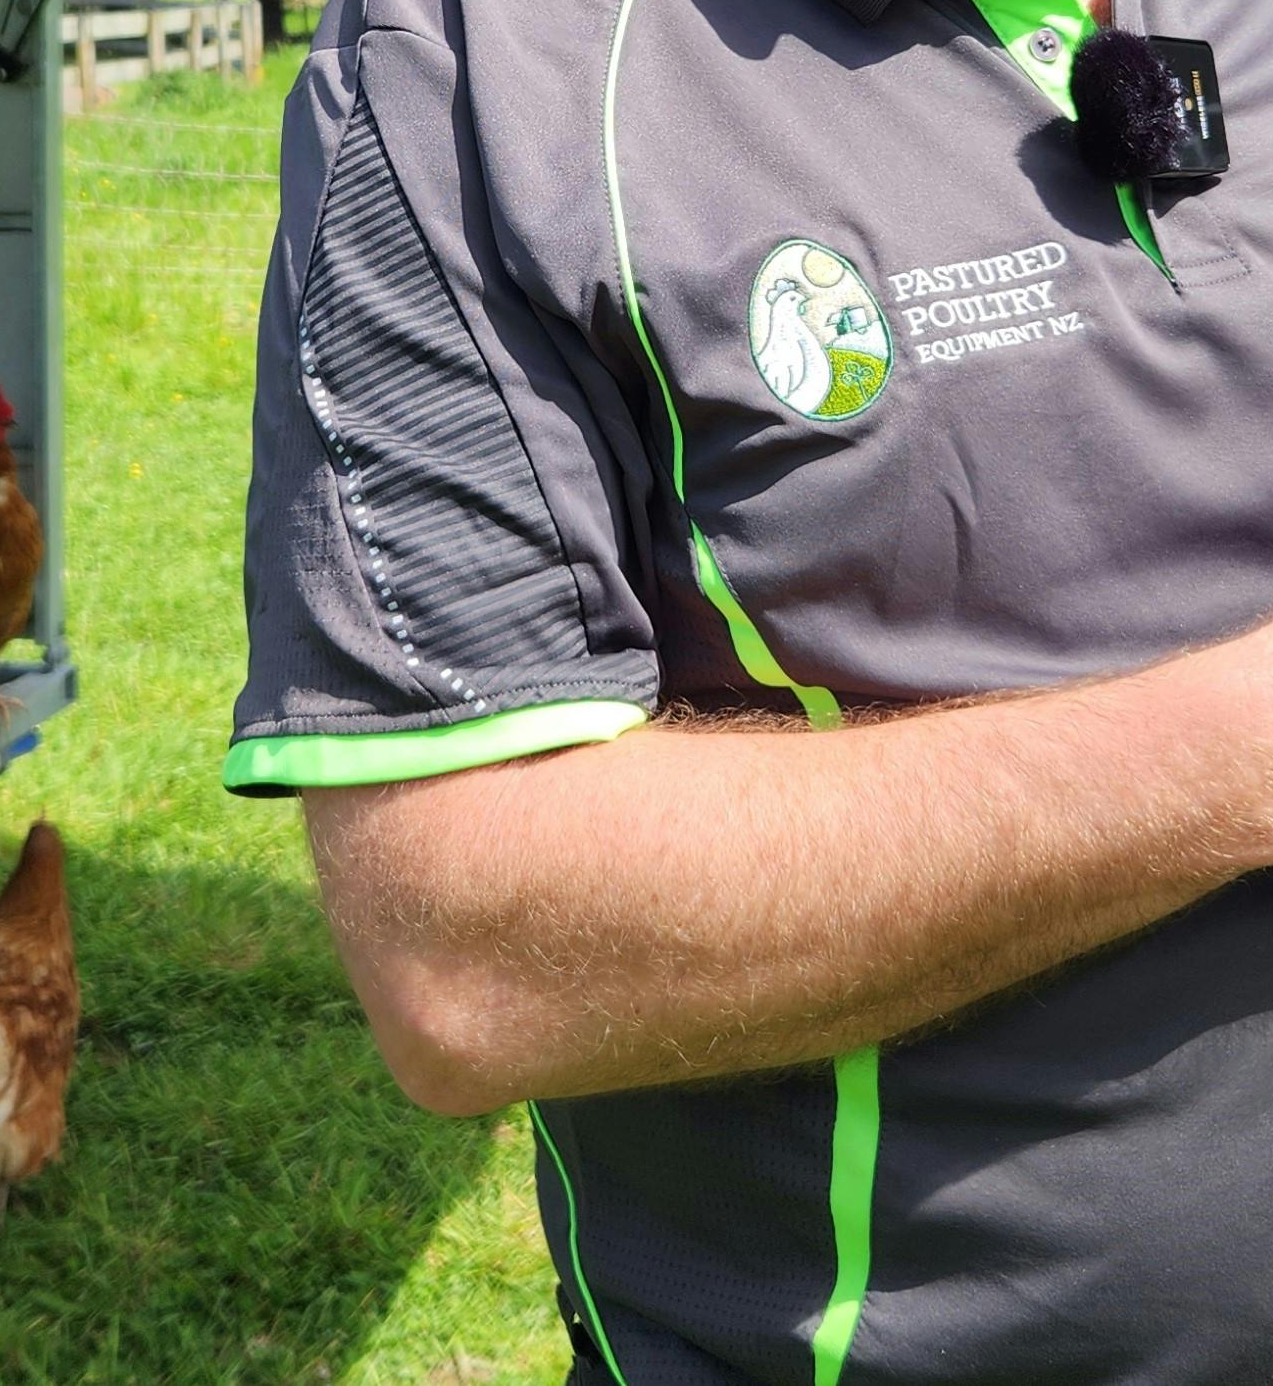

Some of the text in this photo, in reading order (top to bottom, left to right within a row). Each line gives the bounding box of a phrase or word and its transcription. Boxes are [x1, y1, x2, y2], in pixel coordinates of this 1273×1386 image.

[888, 242, 1066, 302] PASTURED
[902, 281, 1055, 336] POULTRY
[915, 312, 1085, 364] EQUIPMENT NZ
